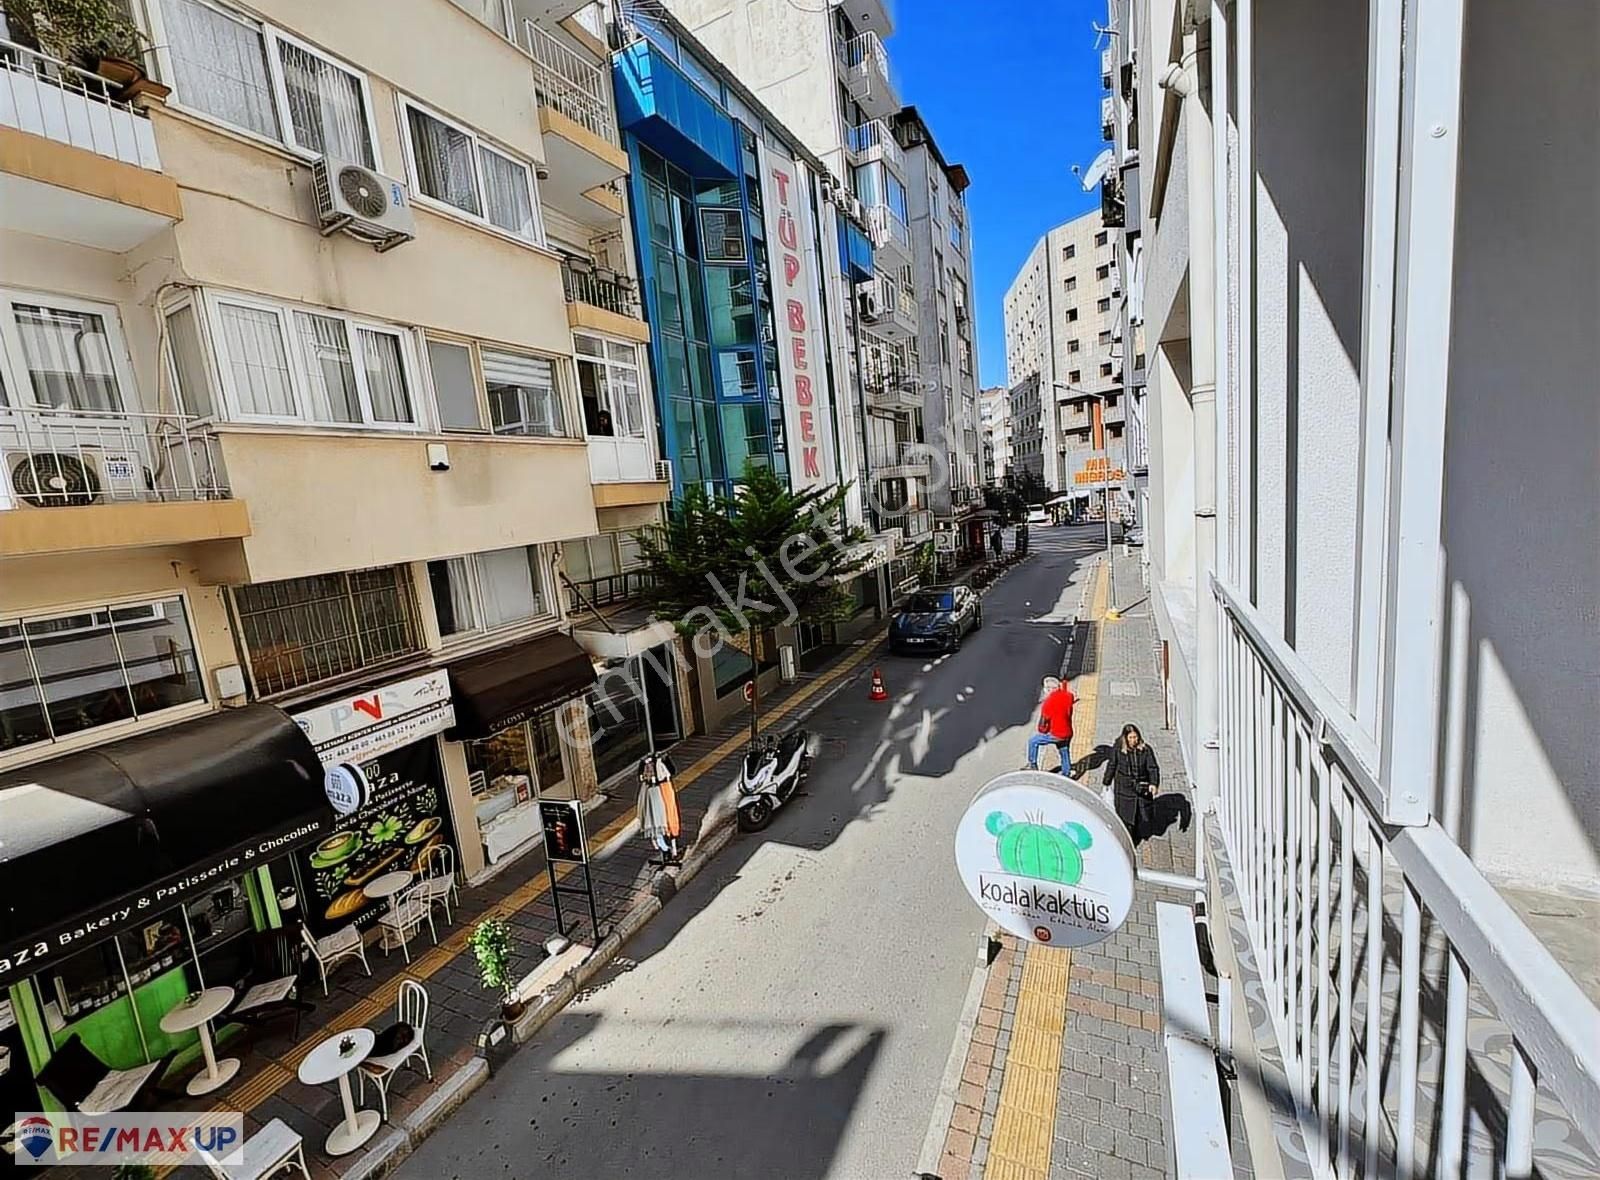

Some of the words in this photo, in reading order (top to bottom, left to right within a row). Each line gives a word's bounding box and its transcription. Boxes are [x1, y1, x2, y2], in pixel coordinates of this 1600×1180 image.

[772, 169, 800, 287] TÜP
[787, 299, 820, 478] BEBEK
[59, 907, 131, 945] Bakery
[138, 898, 150, 909] &
[156, 857, 239, 900] Patisserie
[244, 849, 255, 860] &
[258, 821, 320, 853] Chocolate
[979, 874, 1110, 924] koalakaktüs
